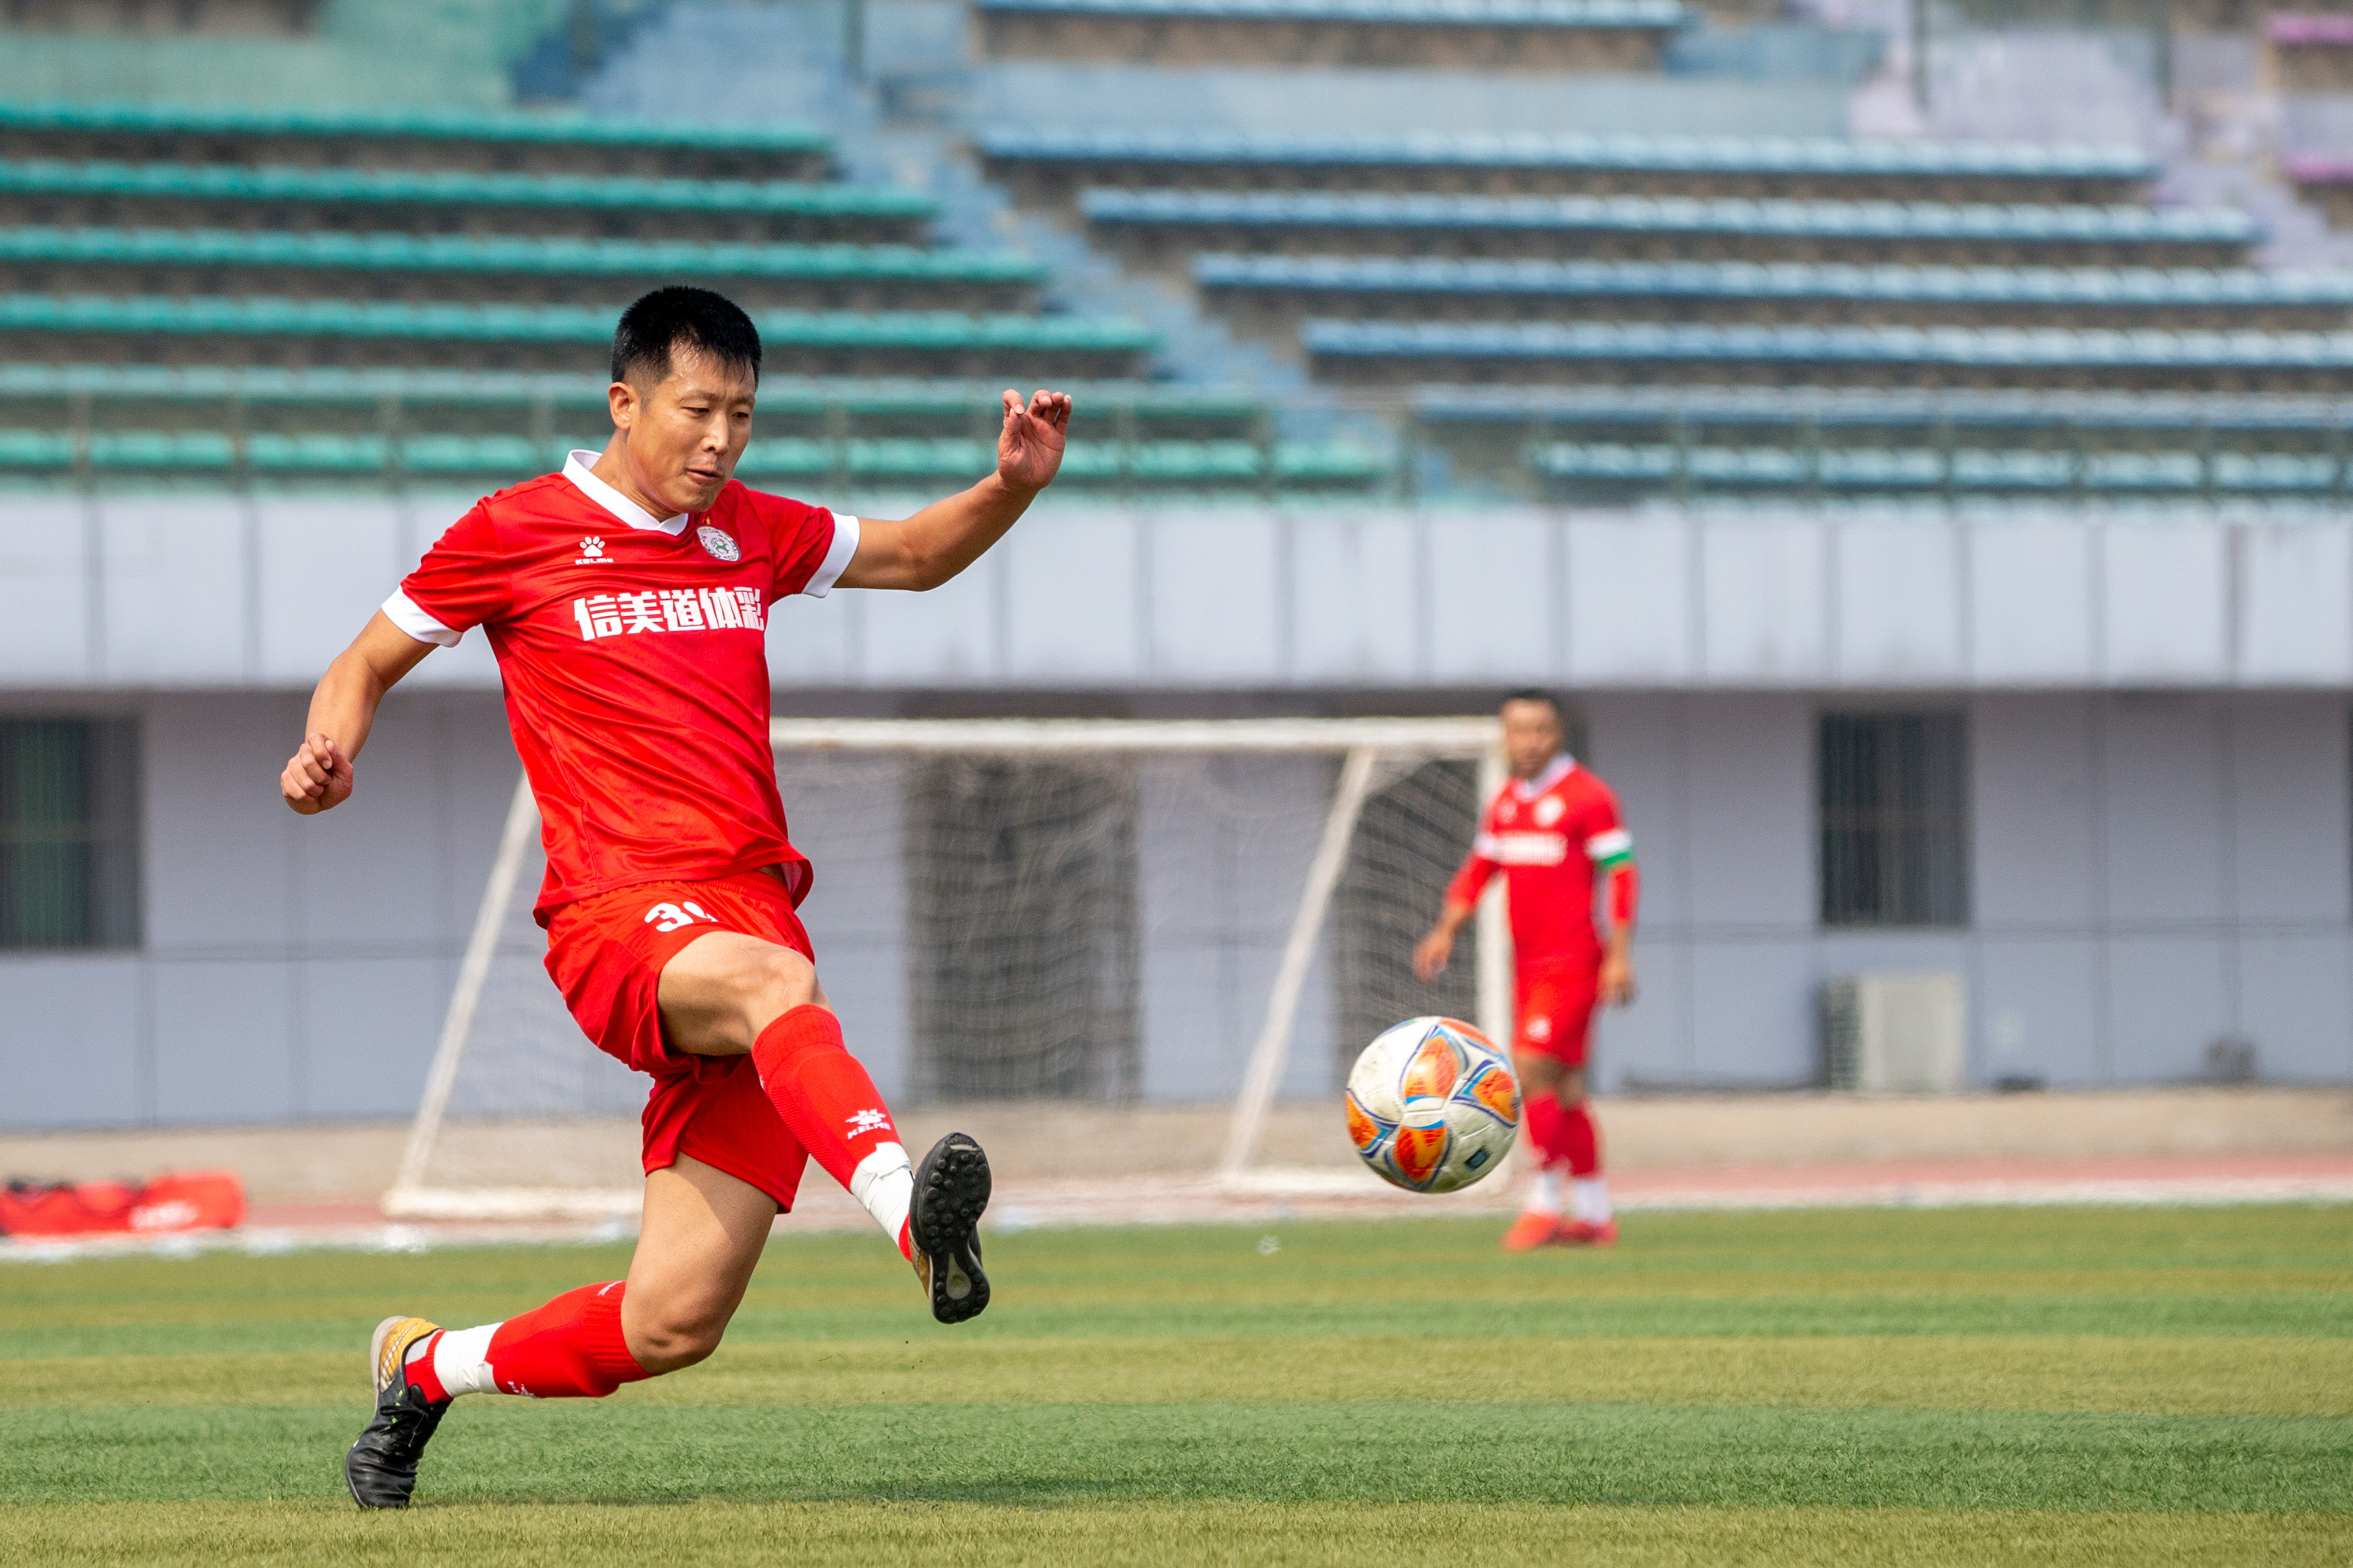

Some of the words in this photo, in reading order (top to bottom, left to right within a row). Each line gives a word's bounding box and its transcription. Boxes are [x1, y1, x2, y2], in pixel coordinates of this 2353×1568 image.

[574, 587, 764, 641] 信美道体彩
